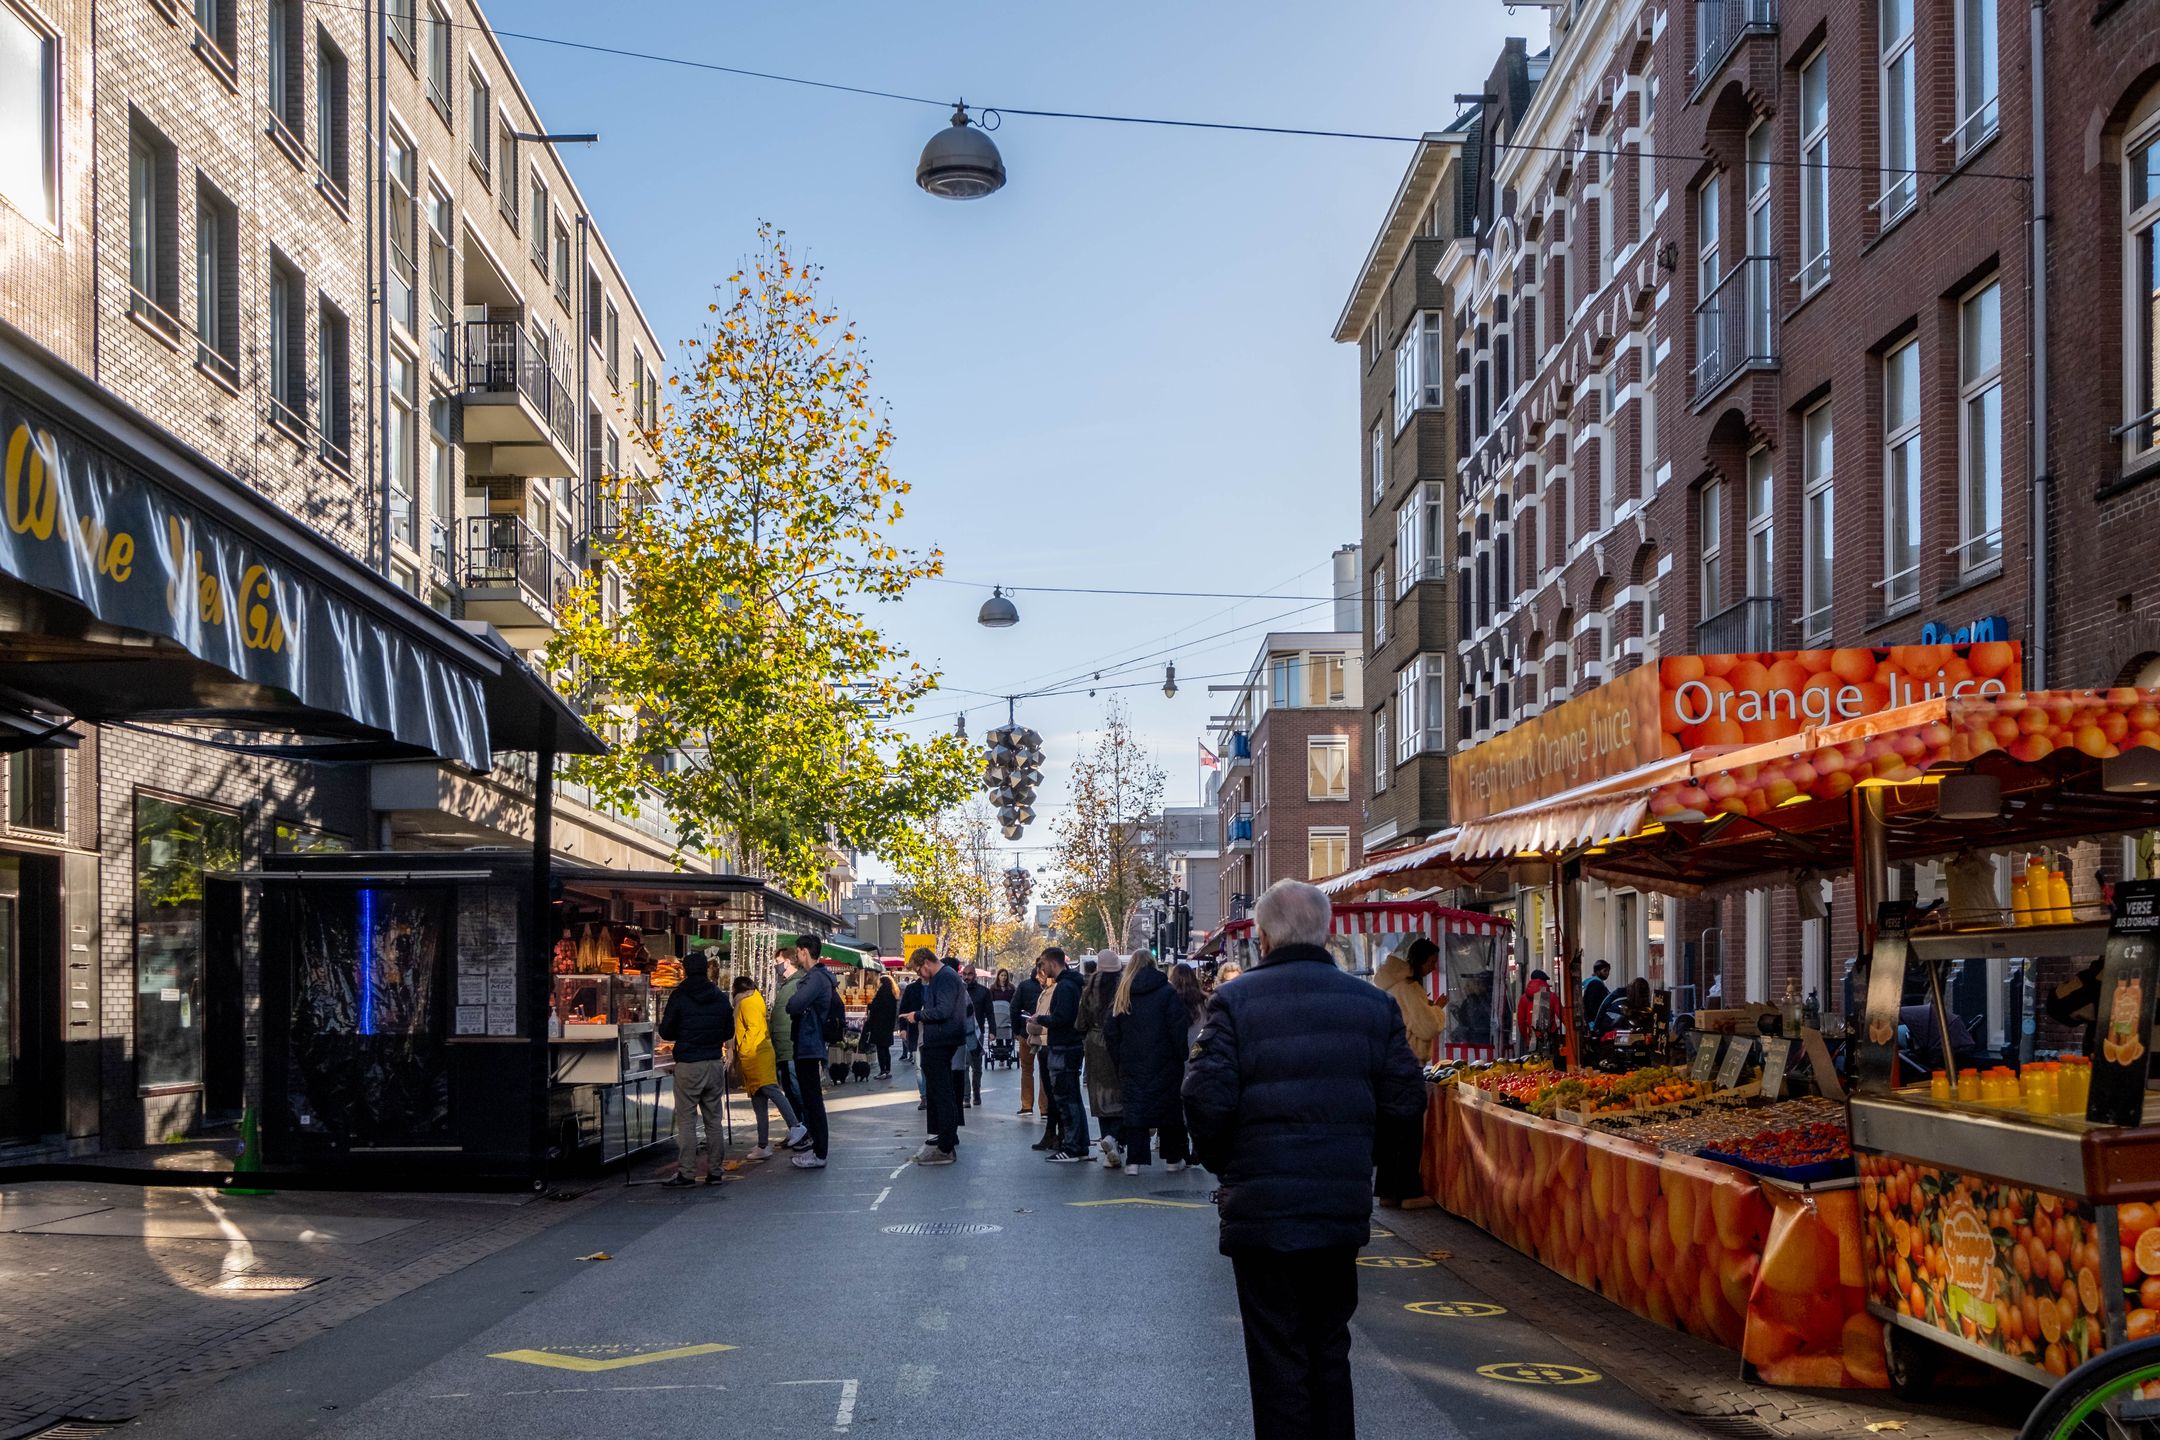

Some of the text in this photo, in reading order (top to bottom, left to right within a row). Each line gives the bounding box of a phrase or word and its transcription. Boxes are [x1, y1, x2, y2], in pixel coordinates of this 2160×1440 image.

[1673, 679, 1864, 727] Orange
[1469, 703, 1632, 801] Fresh Fruit & Orange Juice
[2115, 916, 2160, 928] JUS D'ORANGE
[2126, 901, 2153, 915] VERSE
